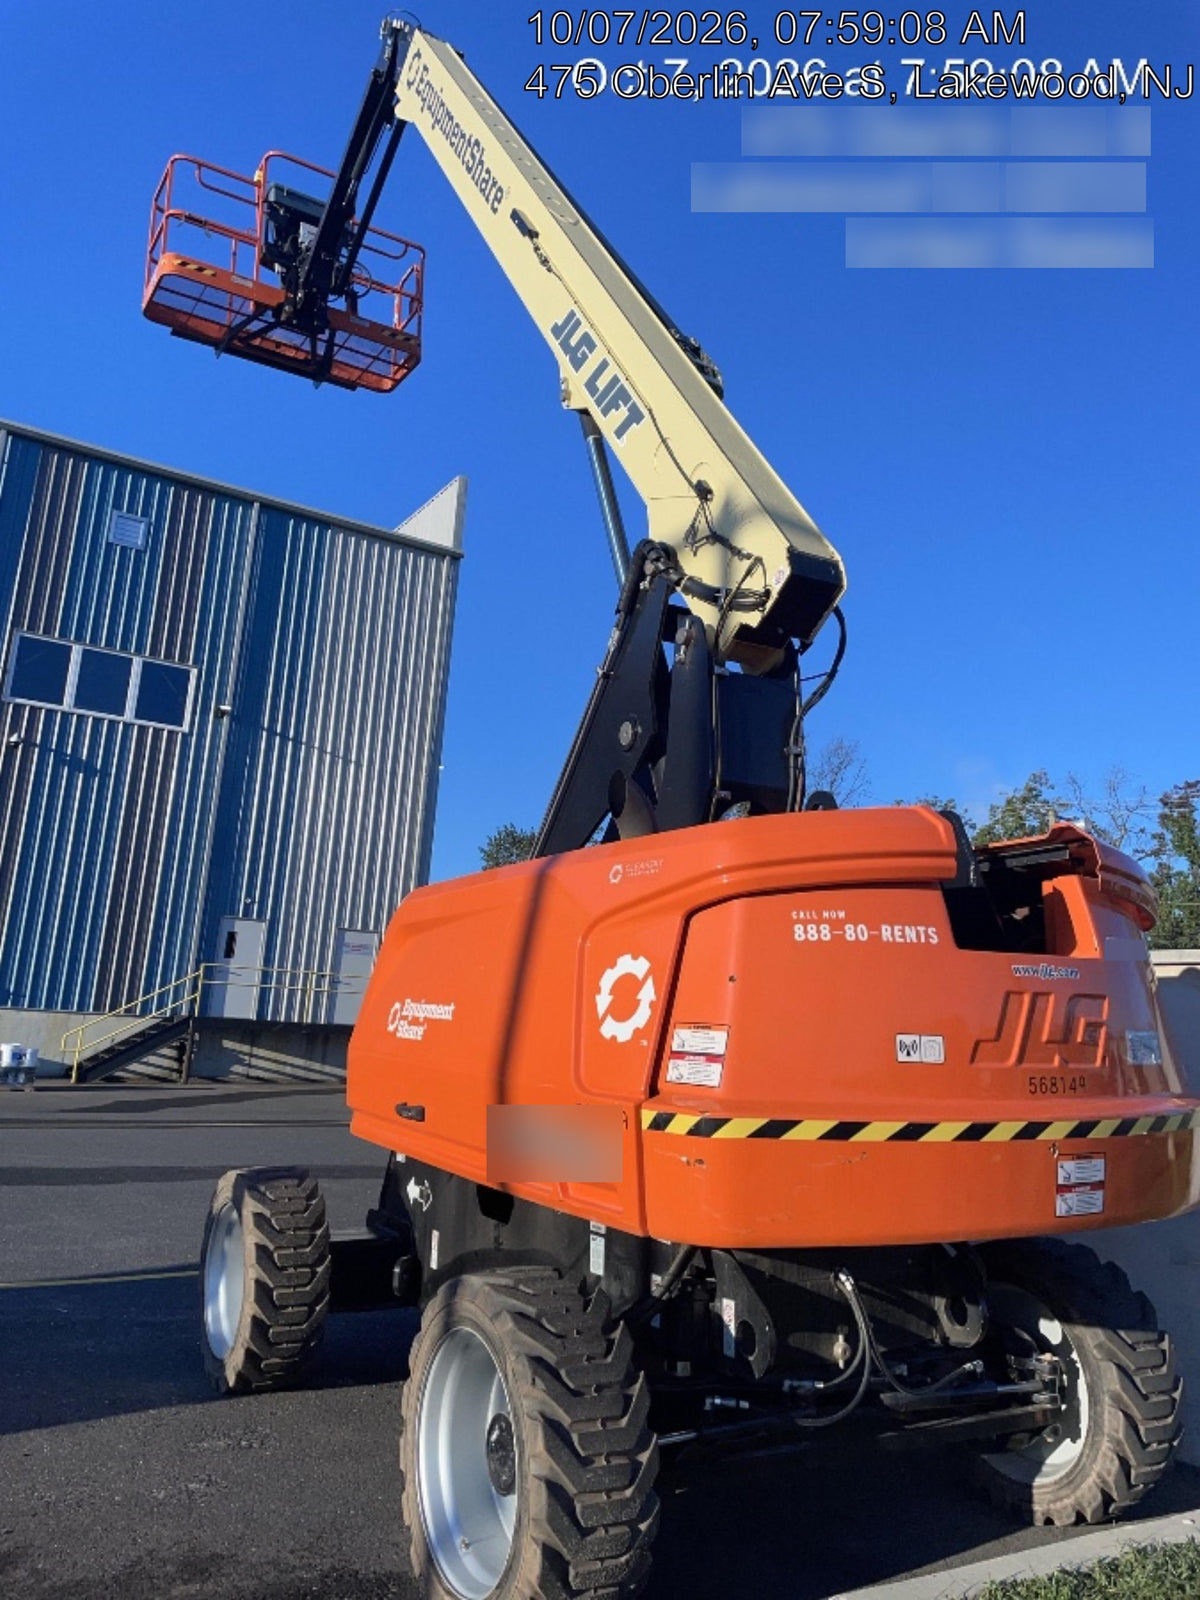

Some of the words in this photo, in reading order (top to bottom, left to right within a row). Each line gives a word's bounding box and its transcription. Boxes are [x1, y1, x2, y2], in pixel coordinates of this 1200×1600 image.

[415, 64, 504, 215] EquipmentShare
[550, 308, 598, 374] JLG
[583, 357, 646, 441] LIFT
[791, 910, 818, 920] CALL
[822, 910, 846, 920] NOW
[793, 923, 939, 945] 888-80-RENTS
[969, 990, 1109, 1068] JLG
